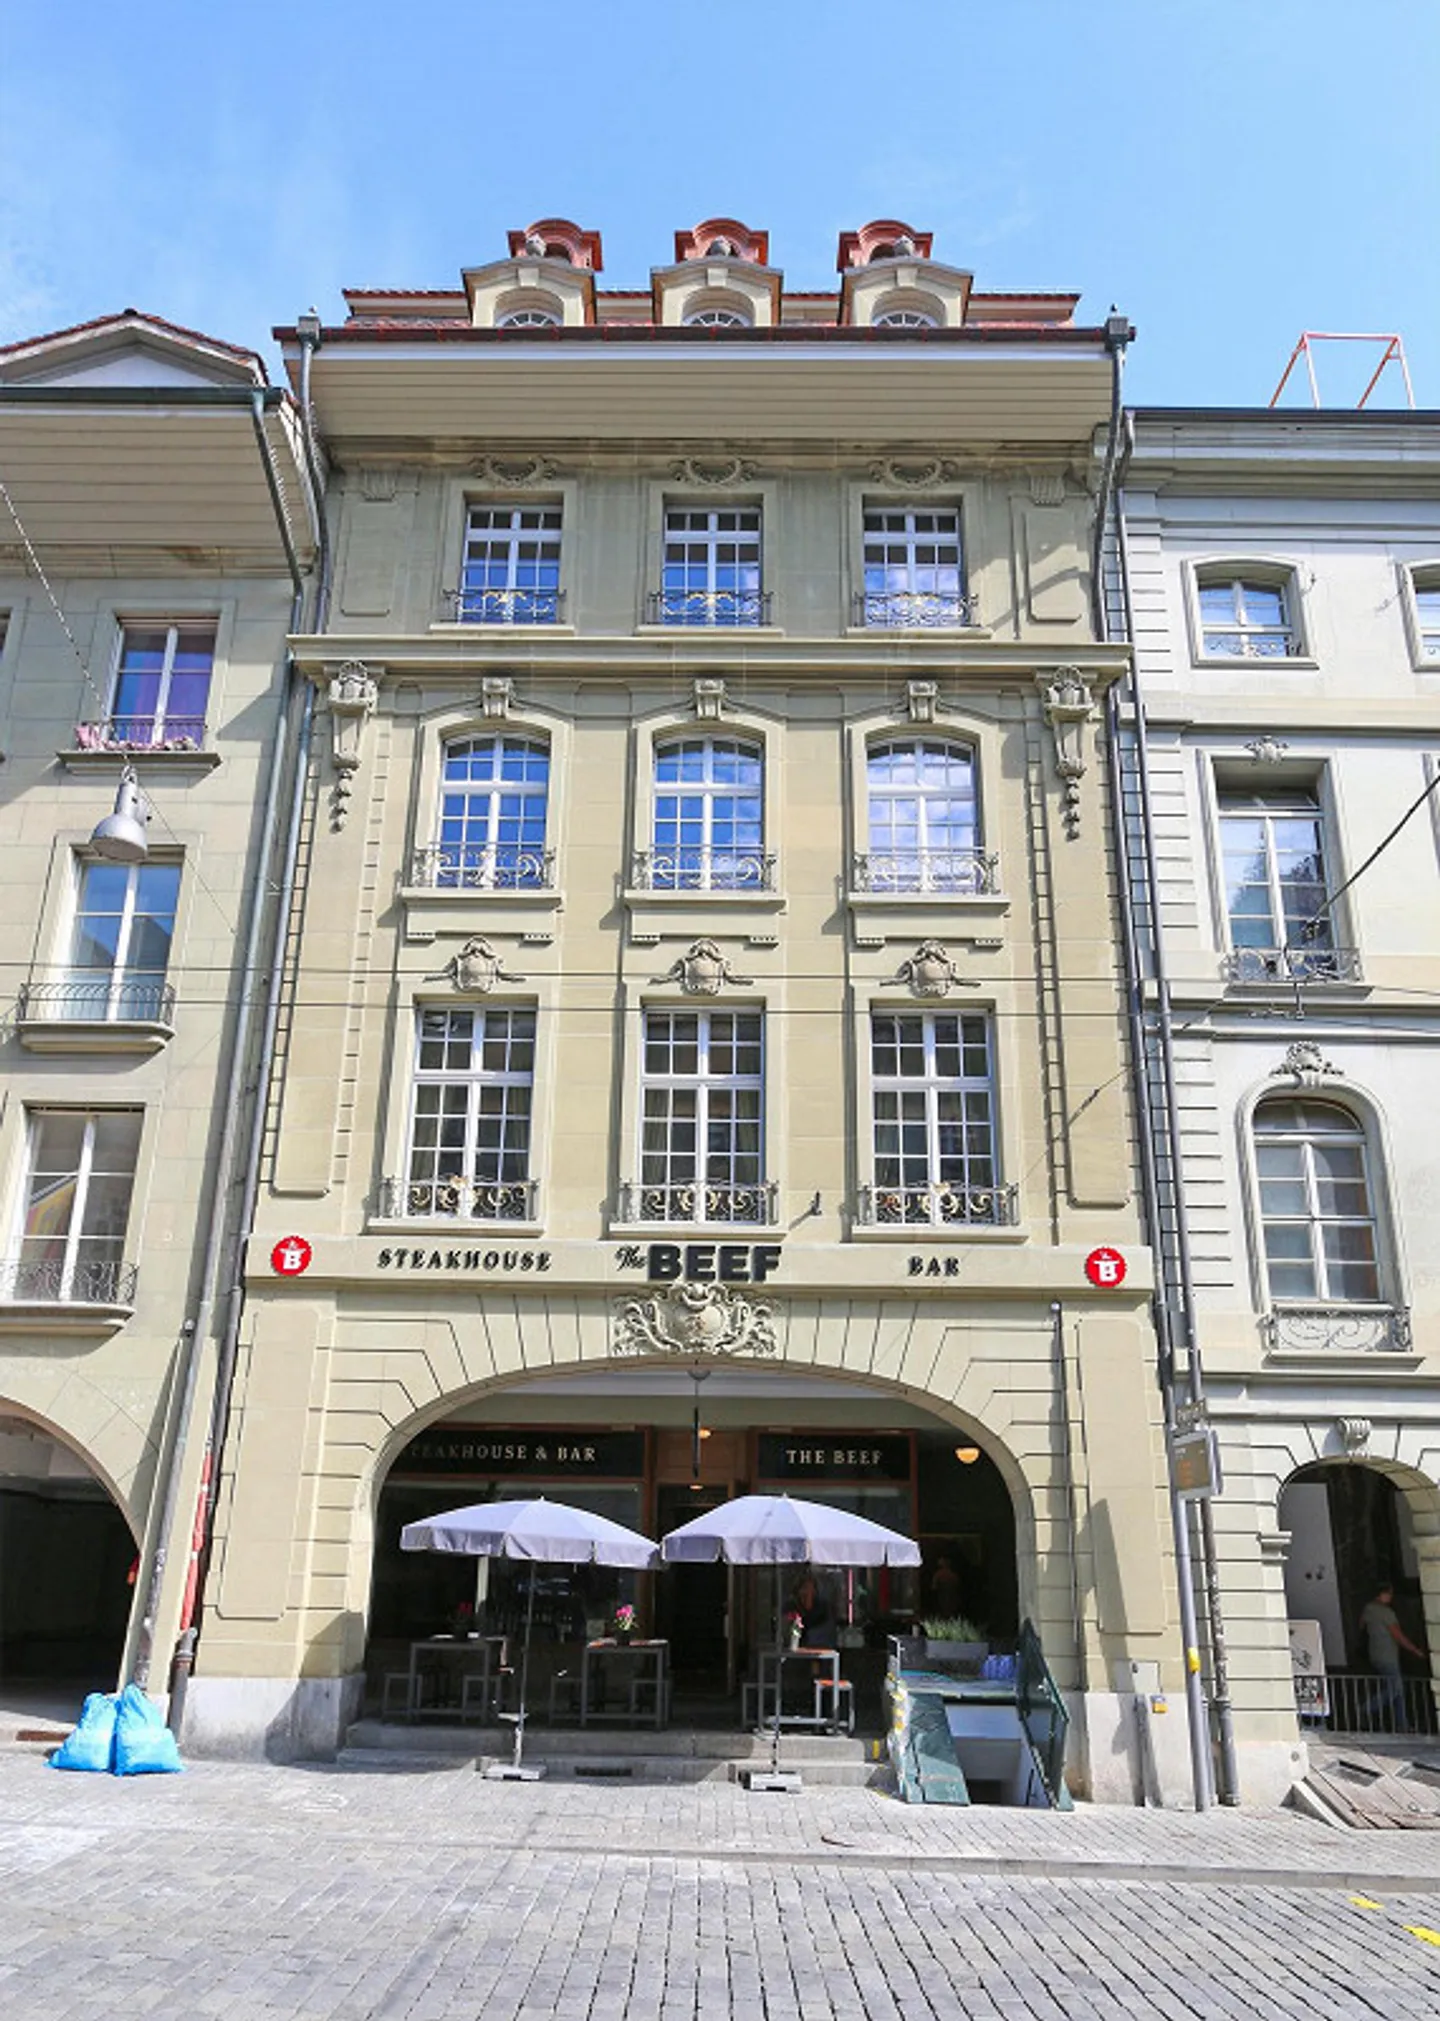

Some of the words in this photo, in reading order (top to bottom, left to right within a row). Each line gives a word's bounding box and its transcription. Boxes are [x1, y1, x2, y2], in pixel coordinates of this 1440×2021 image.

[377, 1248, 552, 1272] STEAKHOUSE
[615, 1245, 647, 1271] The
[648, 1244, 782, 1281] BEEF
[907, 1256, 960, 1277] BAR
[535, 1445, 549, 1461] &
[557, 1446, 597, 1462] BAR
[785, 1449, 825, 1464] THE
[833, 1449, 882, 1465] BEEF
